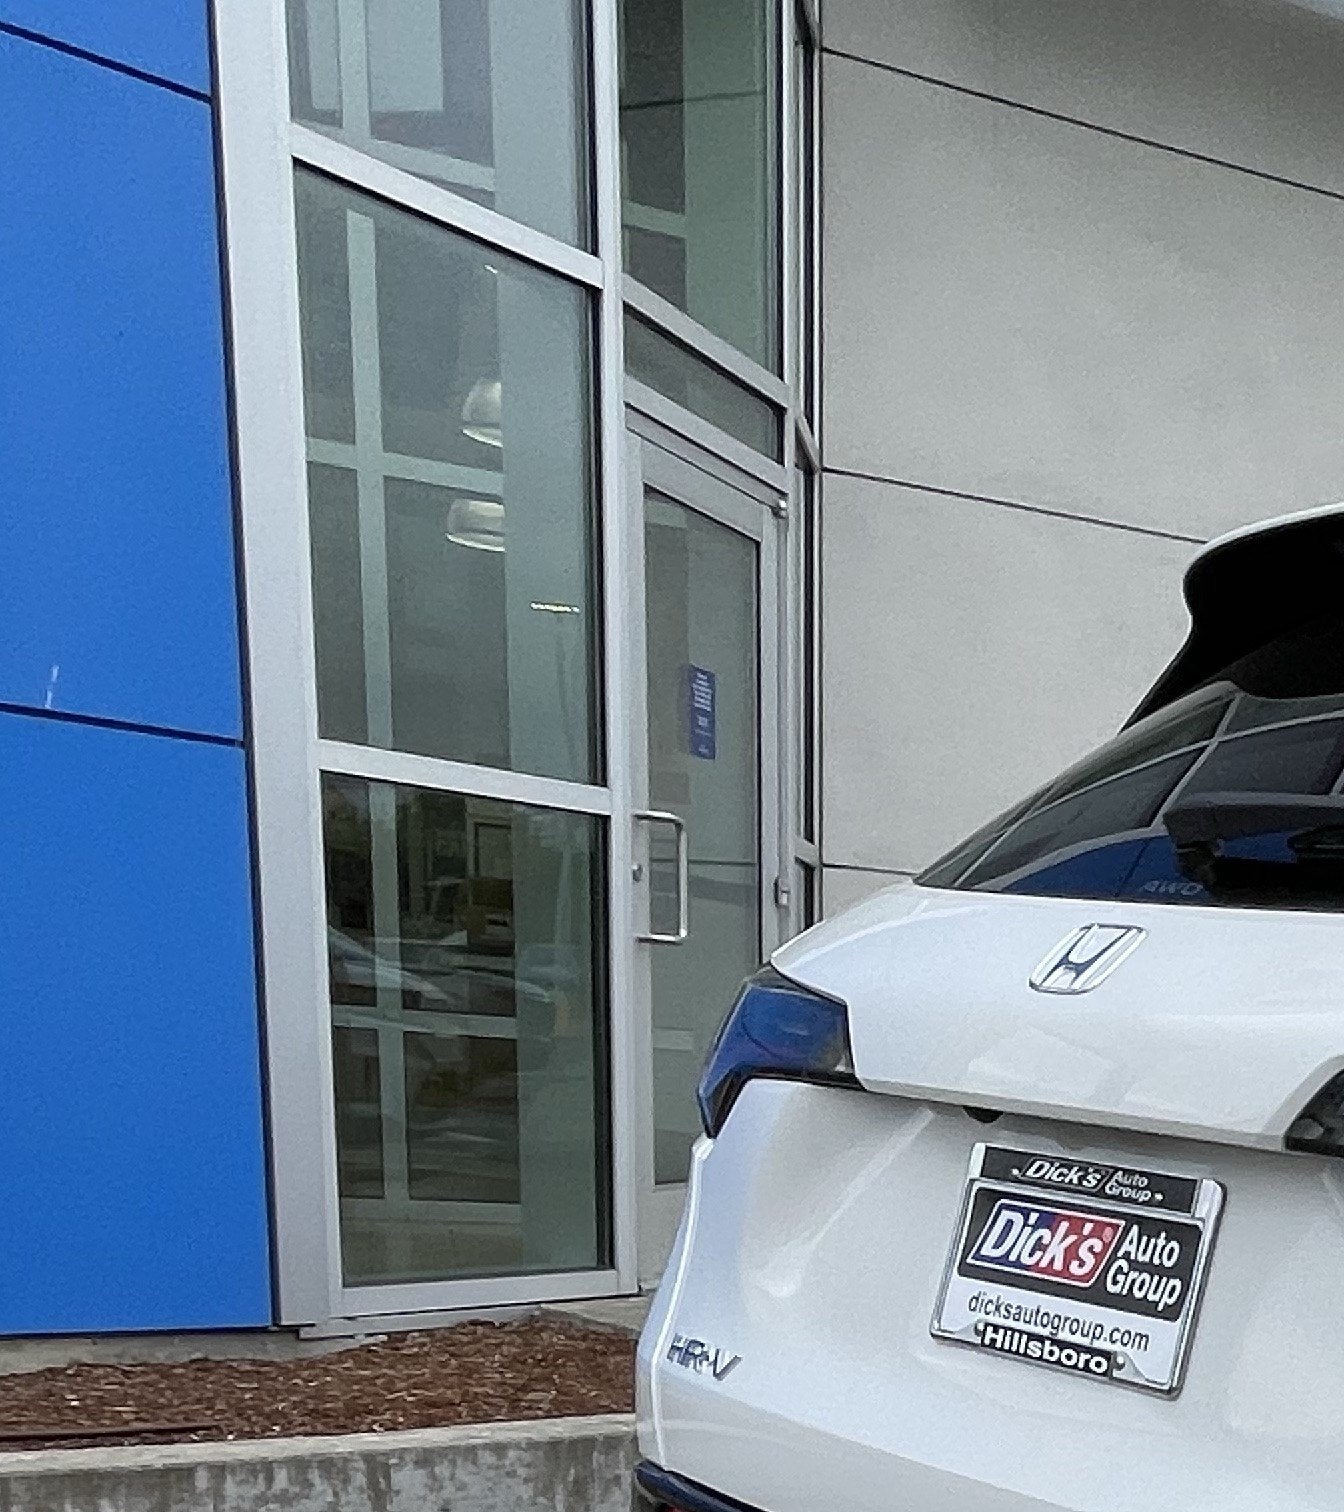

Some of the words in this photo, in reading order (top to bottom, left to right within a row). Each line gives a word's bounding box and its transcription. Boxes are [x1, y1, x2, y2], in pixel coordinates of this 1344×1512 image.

[1025, 1160, 1102, 1188] Dick's
[1104, 1182, 1152, 1202] Group
[1111, 1170, 1149, 1188] Auto
[979, 1210, 1105, 1277] Dick's
[1117, 1224, 1180, 1268] Auto
[1106, 1259, 1182, 1312] Group
[968, 1291, 1150, 1351] dicksautogroup.com
[983, 1323, 1108, 1374] Hillsboro
